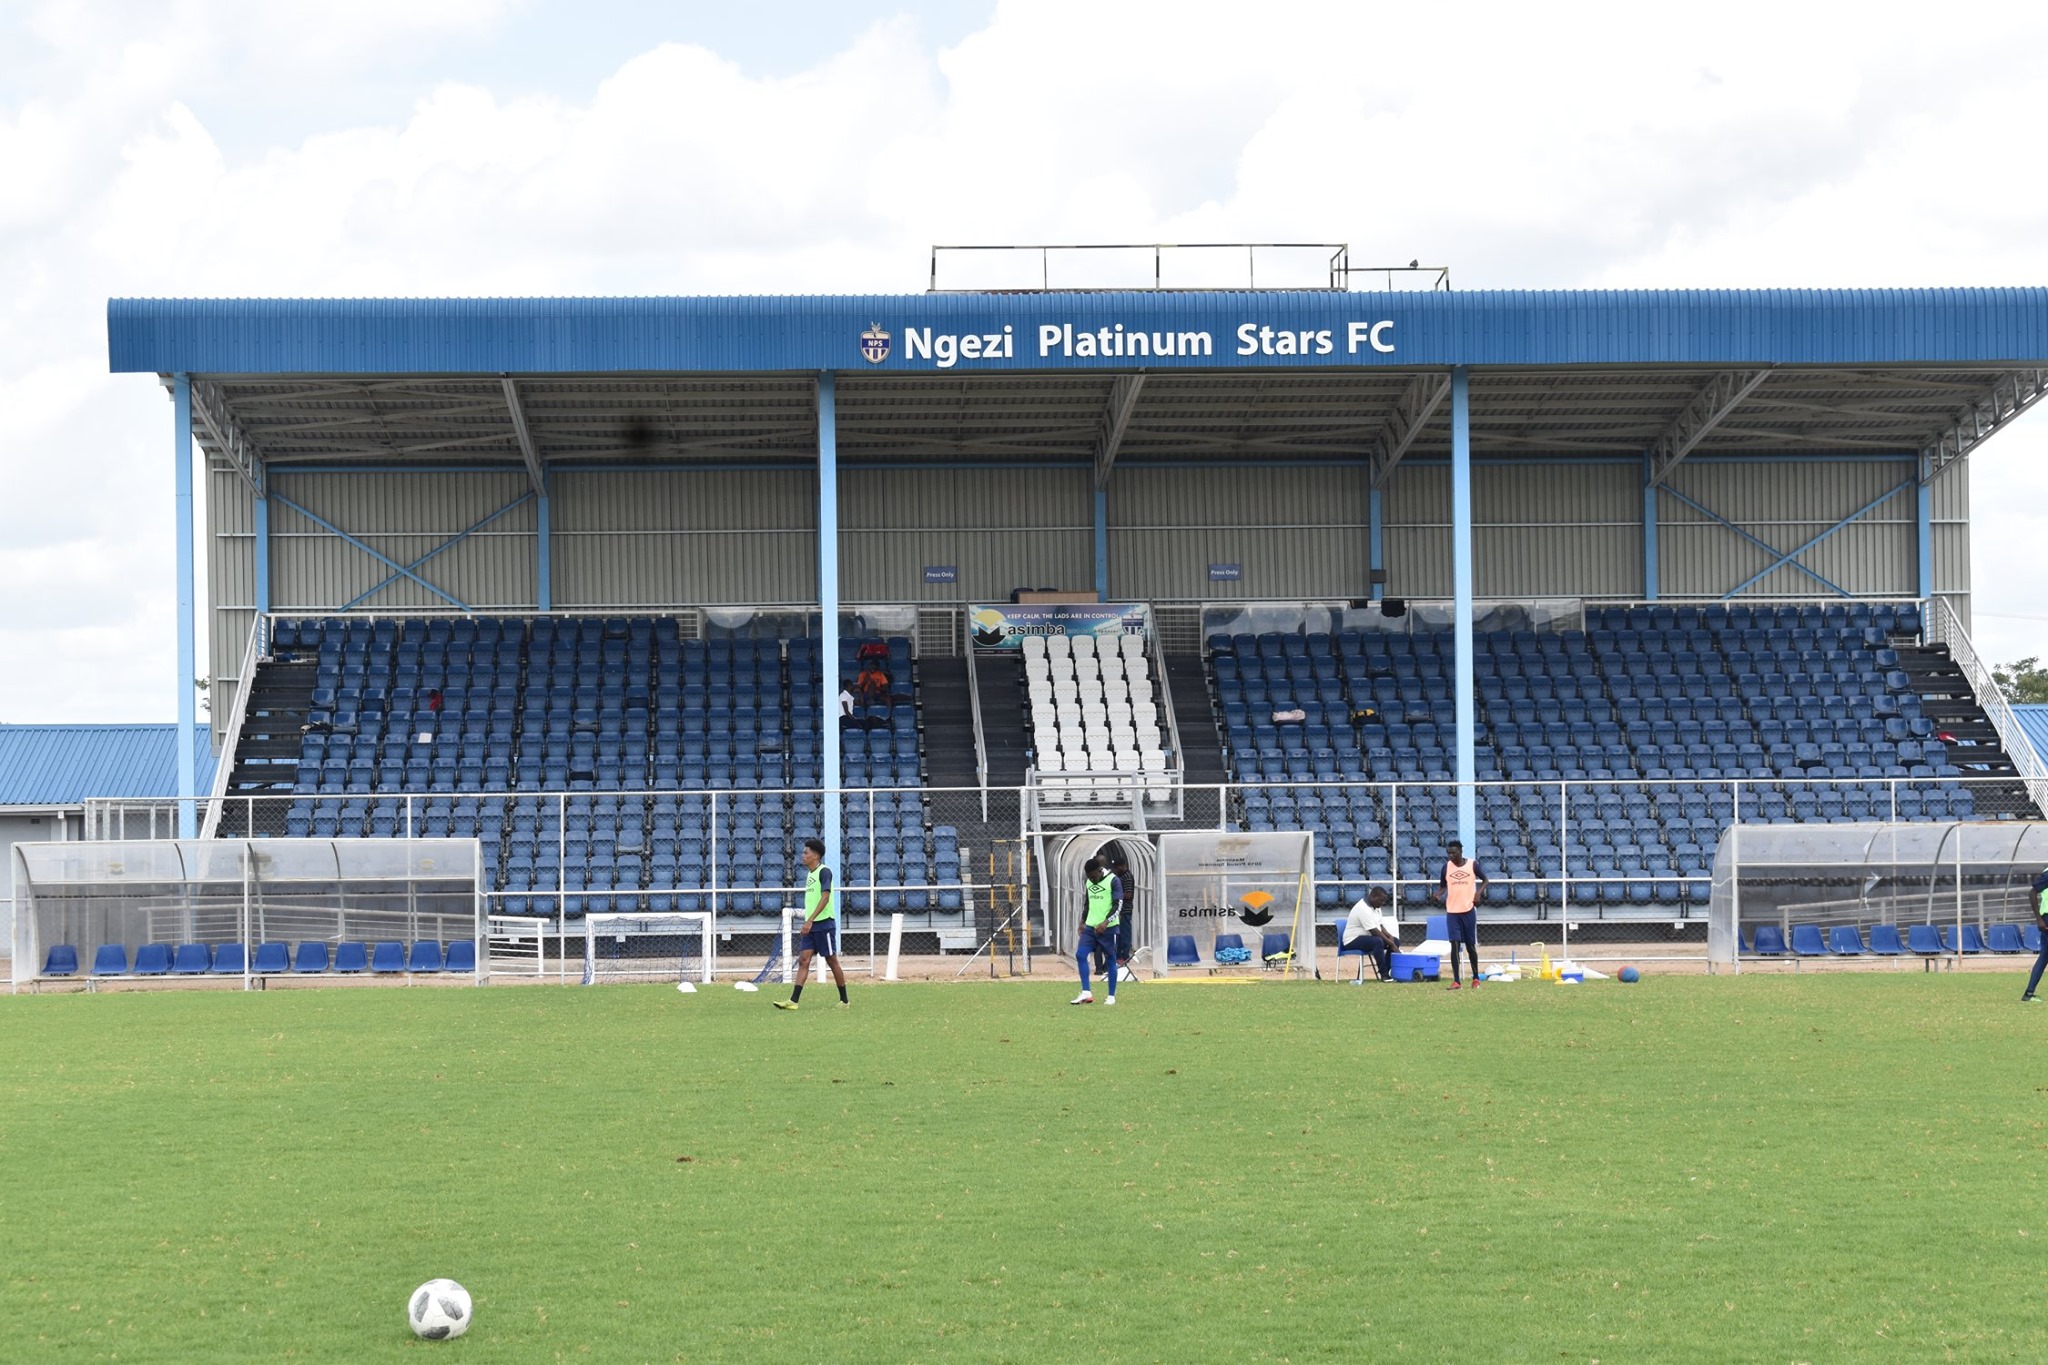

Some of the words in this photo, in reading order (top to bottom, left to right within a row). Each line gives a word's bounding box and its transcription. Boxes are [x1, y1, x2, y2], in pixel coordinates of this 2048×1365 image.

[905, 325, 1014, 368] Ngezi
[1039, 323, 1213, 358] Platinum
[1236, 323, 1334, 356] Stars
[1348, 320, 1396, 354] FC
